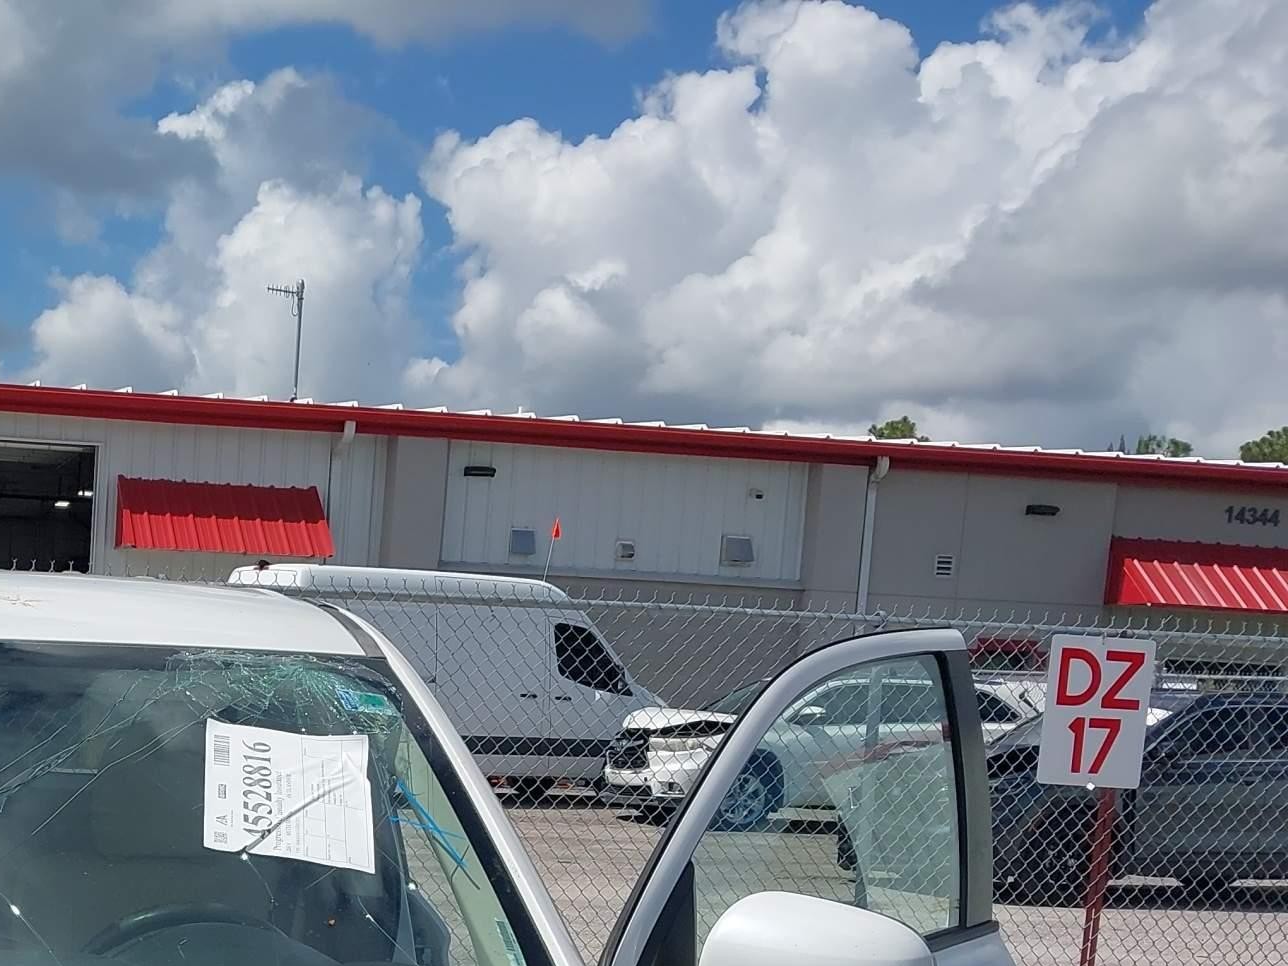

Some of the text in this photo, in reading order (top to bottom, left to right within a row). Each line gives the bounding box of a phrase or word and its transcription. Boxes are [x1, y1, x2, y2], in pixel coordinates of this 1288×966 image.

[1224, 505, 1281, 527] 14344
[1056, 647, 1146, 711] DZ
[1068, 716, 1122, 775] 17
